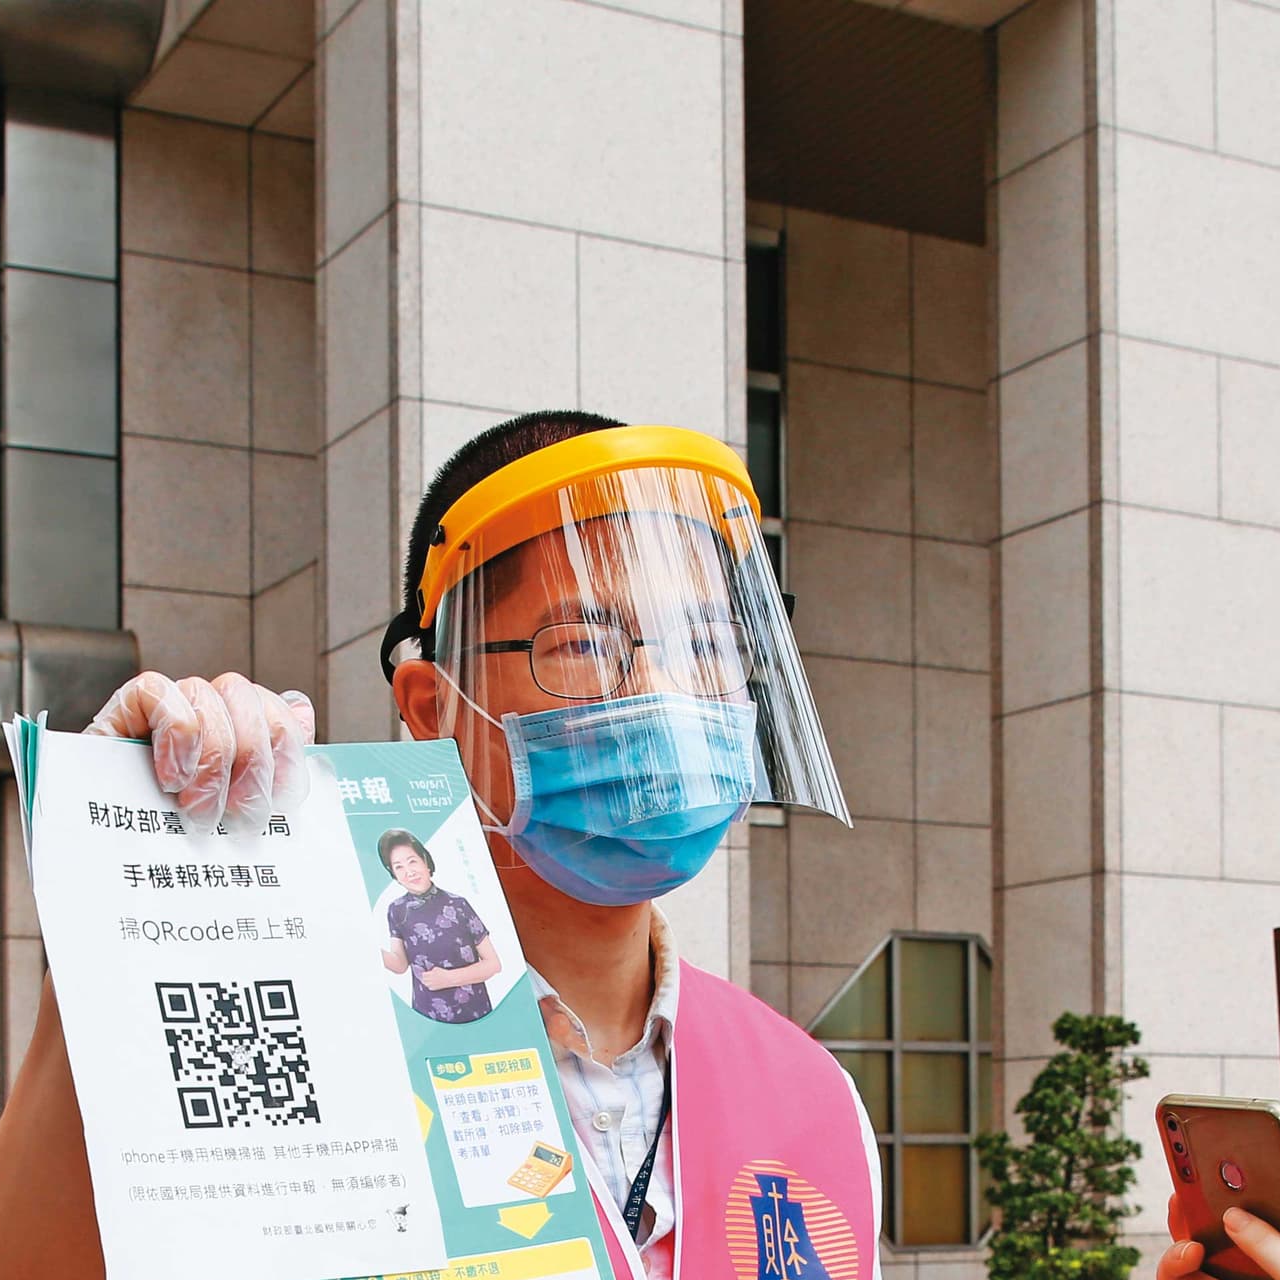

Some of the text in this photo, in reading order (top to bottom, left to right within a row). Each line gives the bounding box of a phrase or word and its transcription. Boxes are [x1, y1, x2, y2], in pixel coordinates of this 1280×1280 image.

[337, 776, 393, 805] 申報
[88, 801, 292, 837] 財政部臺局
[122, 863, 281, 889] 手機報稅專區
[118, 915, 308, 945] 掃QRcode馬上報
[272, 1137, 399, 1161] 其他手機用APP掃描
